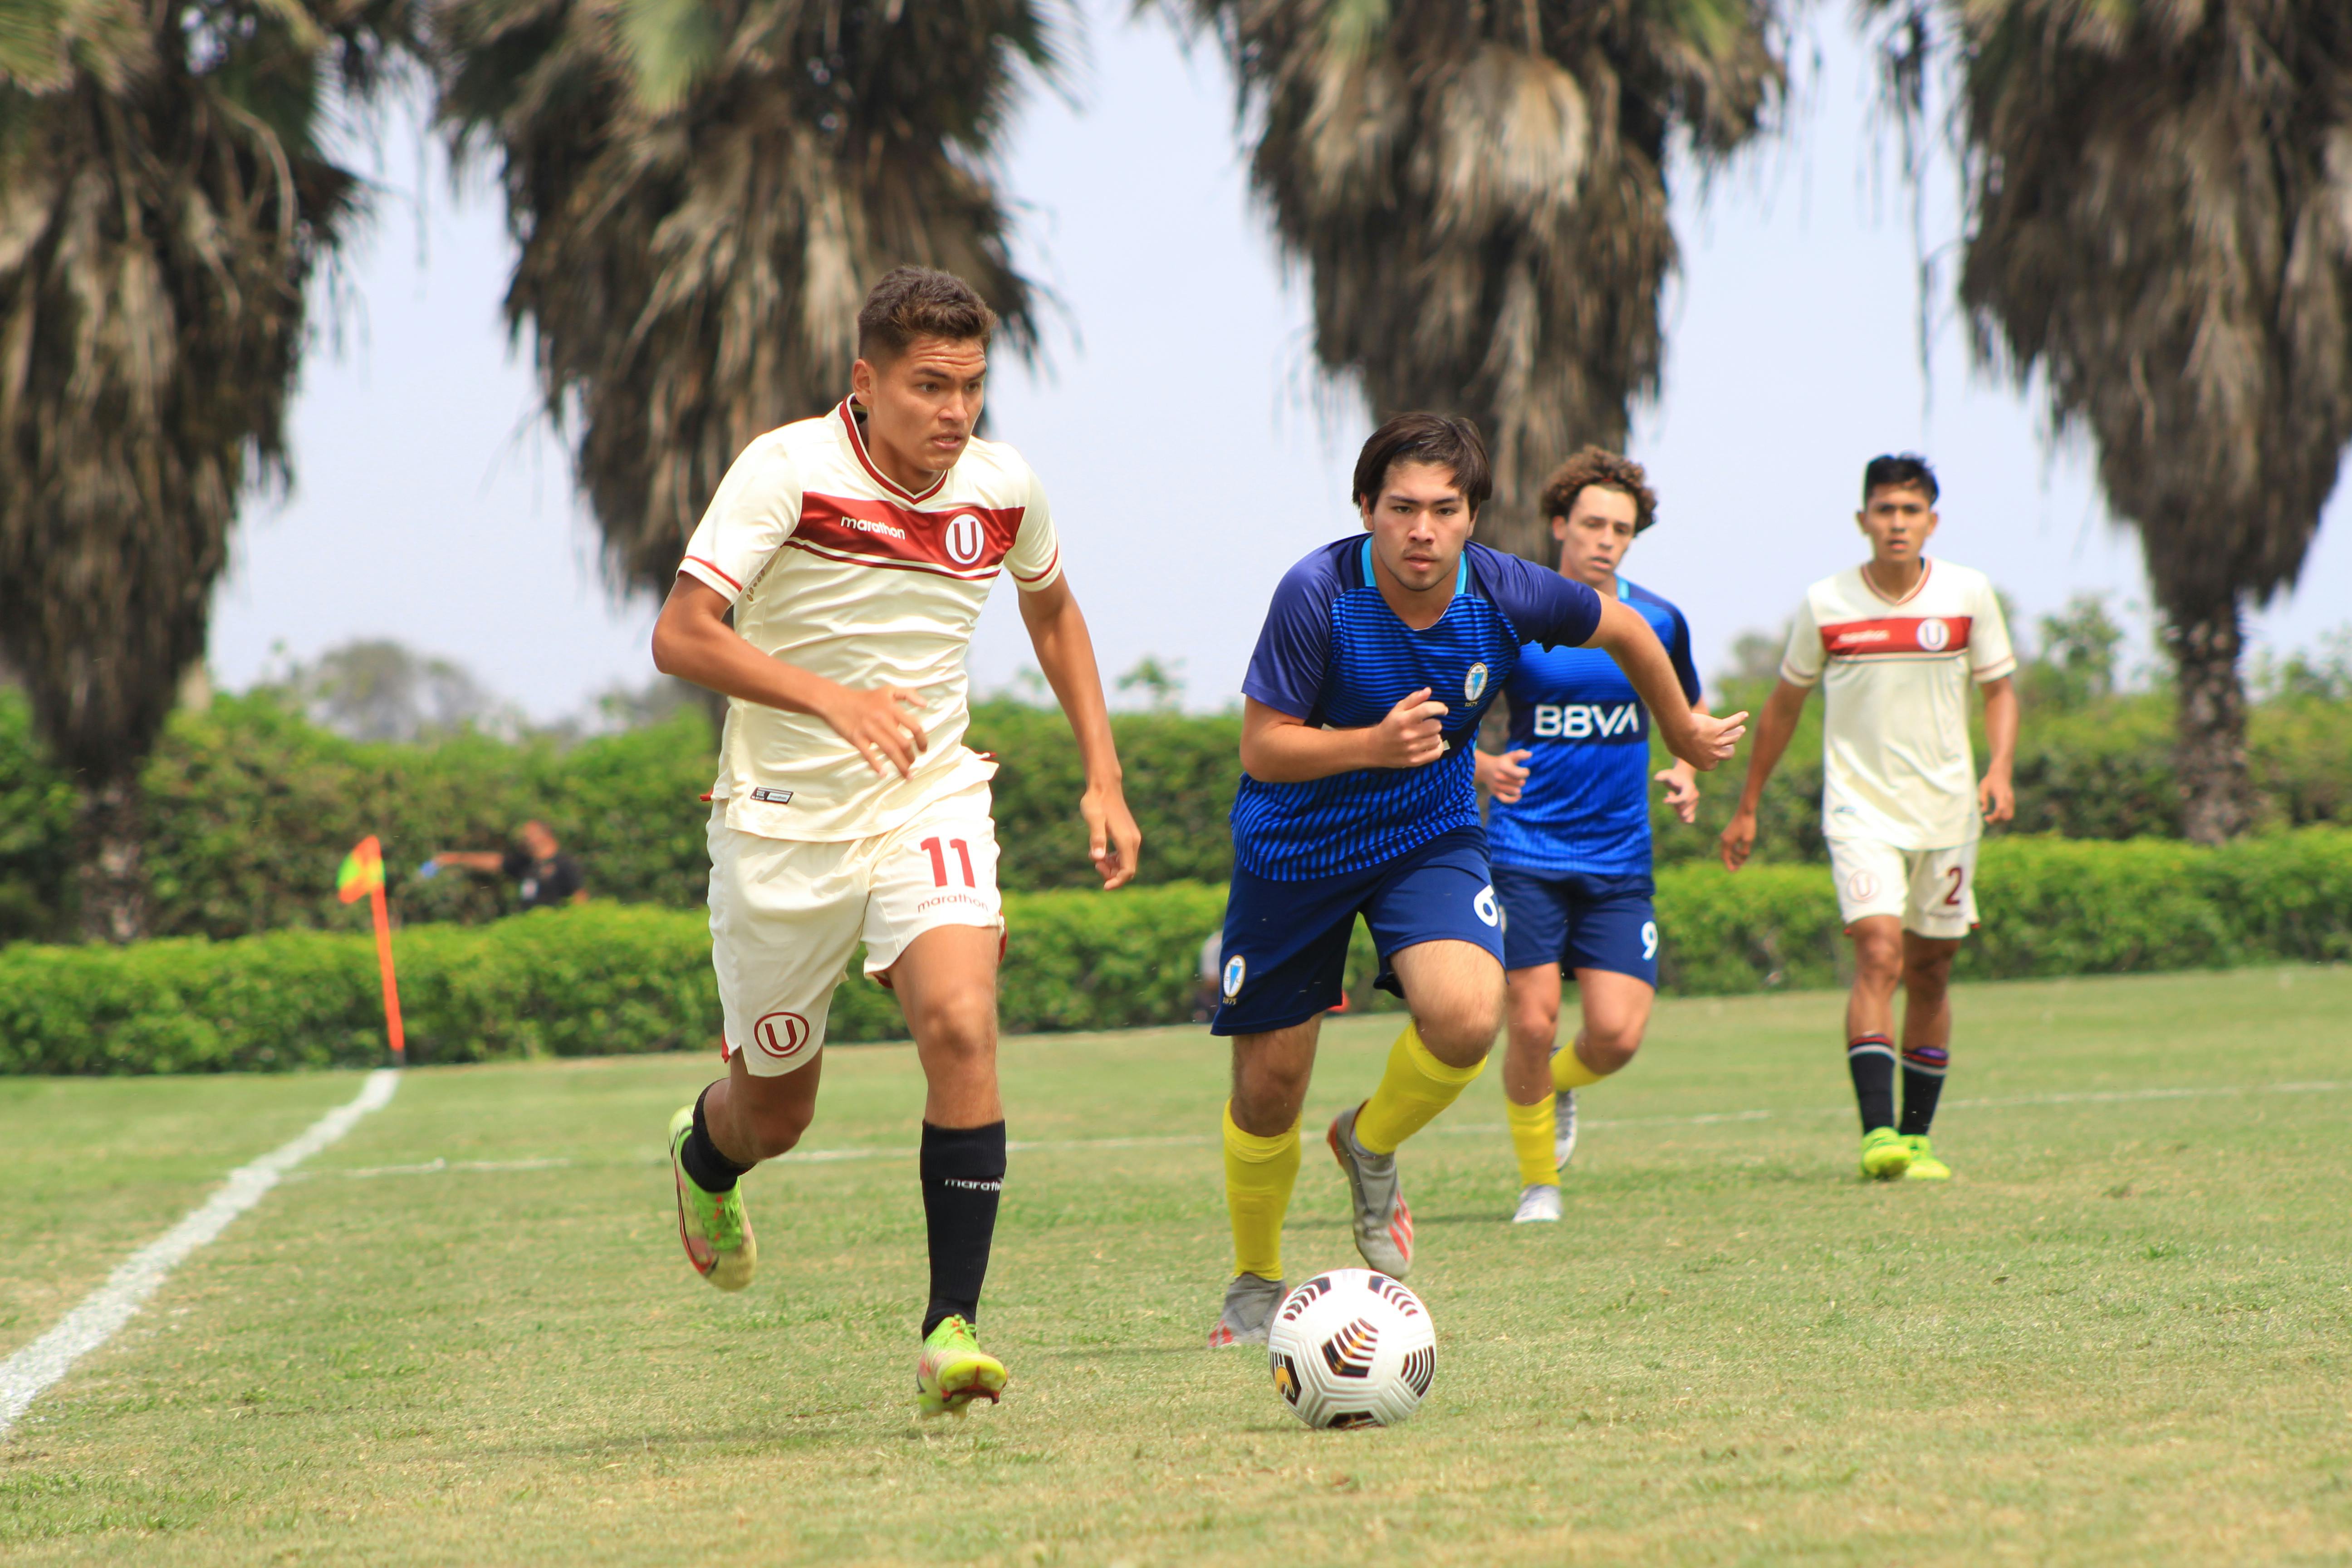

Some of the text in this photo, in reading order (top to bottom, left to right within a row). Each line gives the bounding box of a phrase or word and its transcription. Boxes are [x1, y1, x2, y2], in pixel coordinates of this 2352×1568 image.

[840, 516, 906, 540] marathon
[954, 521, 977, 560] U
[1925, 624, 1942, 645] U
[1534, 703, 1639, 737] BBVA
[920, 837, 975, 888] 11
[917, 894, 988, 914] marathon
[1944, 867, 1963, 905] 2
[1473, 884, 1498, 927] 6
[1641, 921, 1659, 960] 9
[764, 1019, 797, 1051] U
